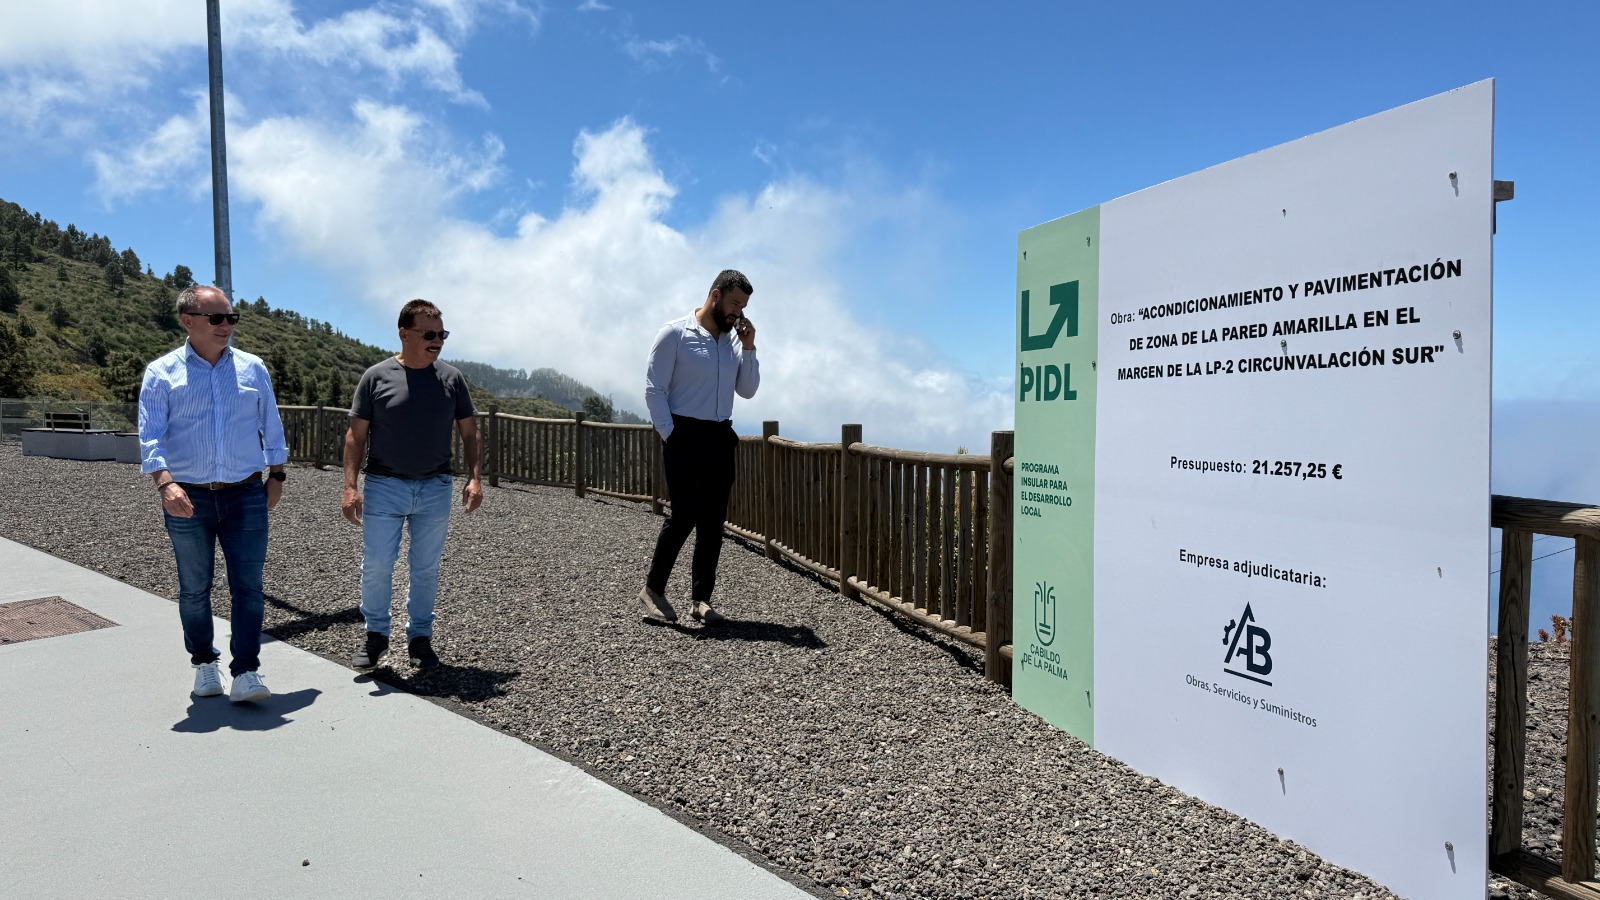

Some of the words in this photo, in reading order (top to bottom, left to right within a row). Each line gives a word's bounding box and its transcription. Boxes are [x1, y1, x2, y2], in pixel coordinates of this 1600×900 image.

[1110, 312, 1135, 324] Obra:
[1288, 284, 1299, 299] Y
[1304, 258, 1462, 297] PAVIMENTACIÓN
[1130, 338, 1143, 350] DE
[1146, 334, 1178, 349] ZONA
[1182, 331, 1198, 345] DE
[1202, 329, 1218, 343] LA
[1222, 322, 1268, 341] PARED
[1272, 313, 1358, 336] AMARILLA
[1364, 310, 1388, 328] EN
[1396, 306, 1420, 324] EL
[1118, 365, 1163, 380] MARGEN
[1167, 364, 1182, 377] DE
[1186, 362, 1202, 376] LA
[1206, 360, 1234, 375] LP-2
[1238, 346, 1385, 374] CIRCUNVALACIÓN
[1020, 363, 1077, 402] PIDL
[1022, 462, 1059, 474] PROGRAMA
[1170, 456, 1246, 474] Presupuesto:
[1252, 460, 1326, 480] 21.257,25
[1332, 464, 1342, 480] €
[1021, 476, 1048, 488] INSULAR
[1050, 480, 1068, 490] PARA
[1021, 491, 1028, 500] EL
[1028, 492, 1072, 506] DESARROLLO
[1021, 506, 1042, 517] LOCAL
[1179, 549, 1228, 570] Empresa
[1234, 560, 1326, 588] adjudicataria:
[1024, 653, 1032, 665] DE
[1034, 658, 1042, 670] LA
[1044, 662, 1068, 680] PALMA
[1030, 644, 1060, 664] CABILDO
[1186, 674, 1212, 692] Obras,
[1213, 683, 1251, 705] Servicios
[1252, 698, 1258, 710] y
[1260, 699, 1317, 728] Suministros
